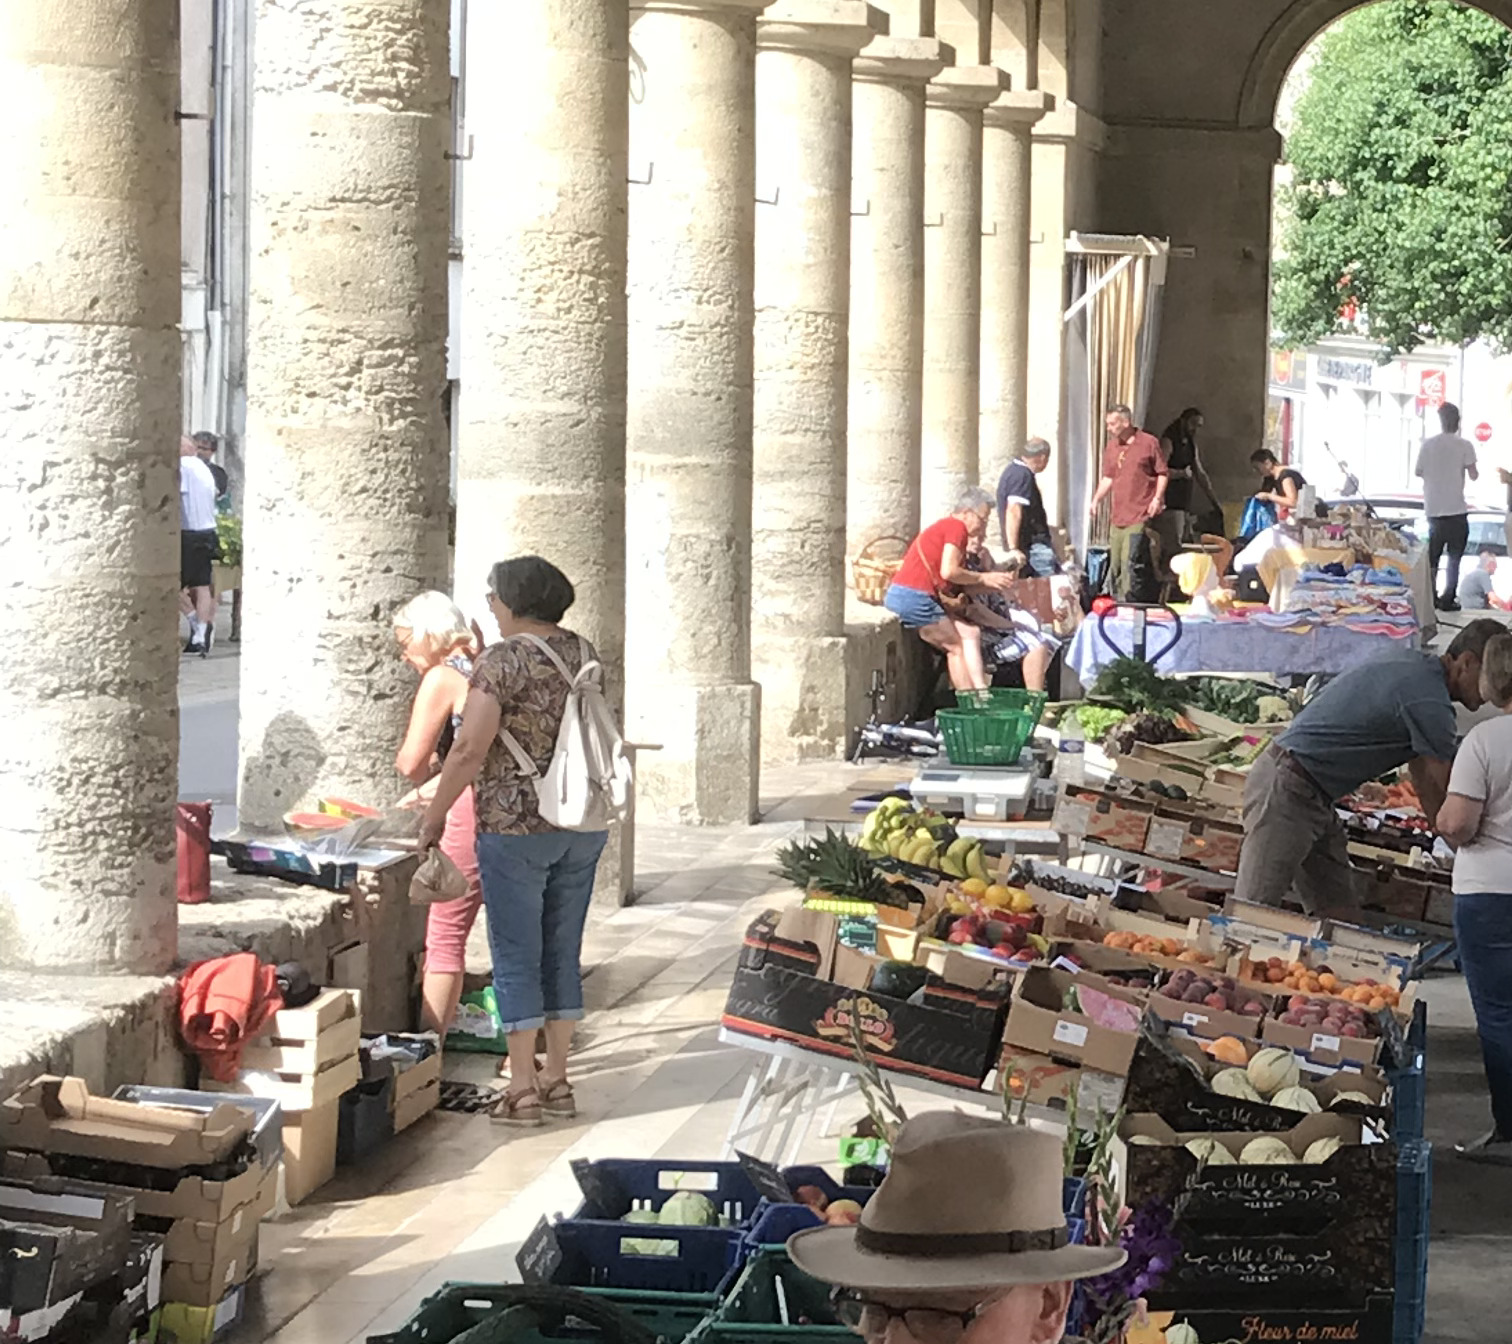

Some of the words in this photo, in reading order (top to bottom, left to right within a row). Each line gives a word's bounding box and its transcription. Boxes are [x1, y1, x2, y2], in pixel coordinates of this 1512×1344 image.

[1241, 1316, 1292, 1344] Fleur
[1296, 1321, 1318, 1340] de
[1320, 1320, 1359, 1340] miel
